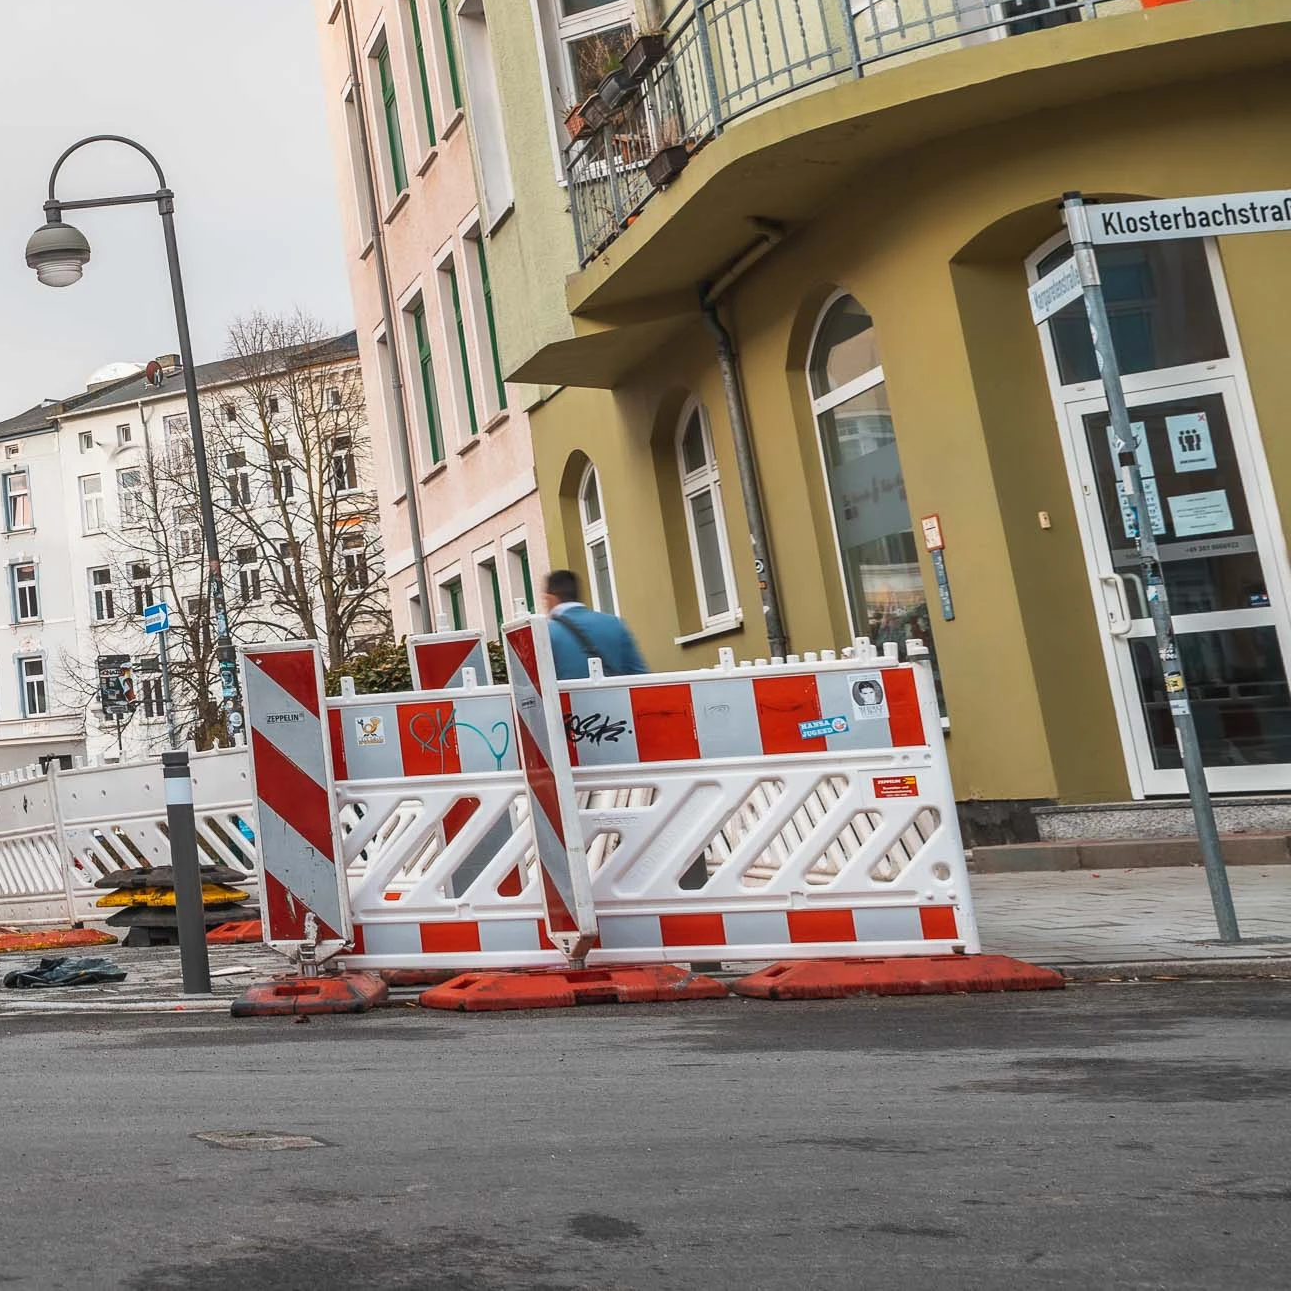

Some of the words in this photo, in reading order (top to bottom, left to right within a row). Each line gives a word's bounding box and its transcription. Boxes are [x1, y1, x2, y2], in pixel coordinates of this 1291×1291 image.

[267, 714, 299, 723] ZEPPELIN
[800, 720, 831, 730] HANSA
[802, 727, 834, 738] JUGEND
